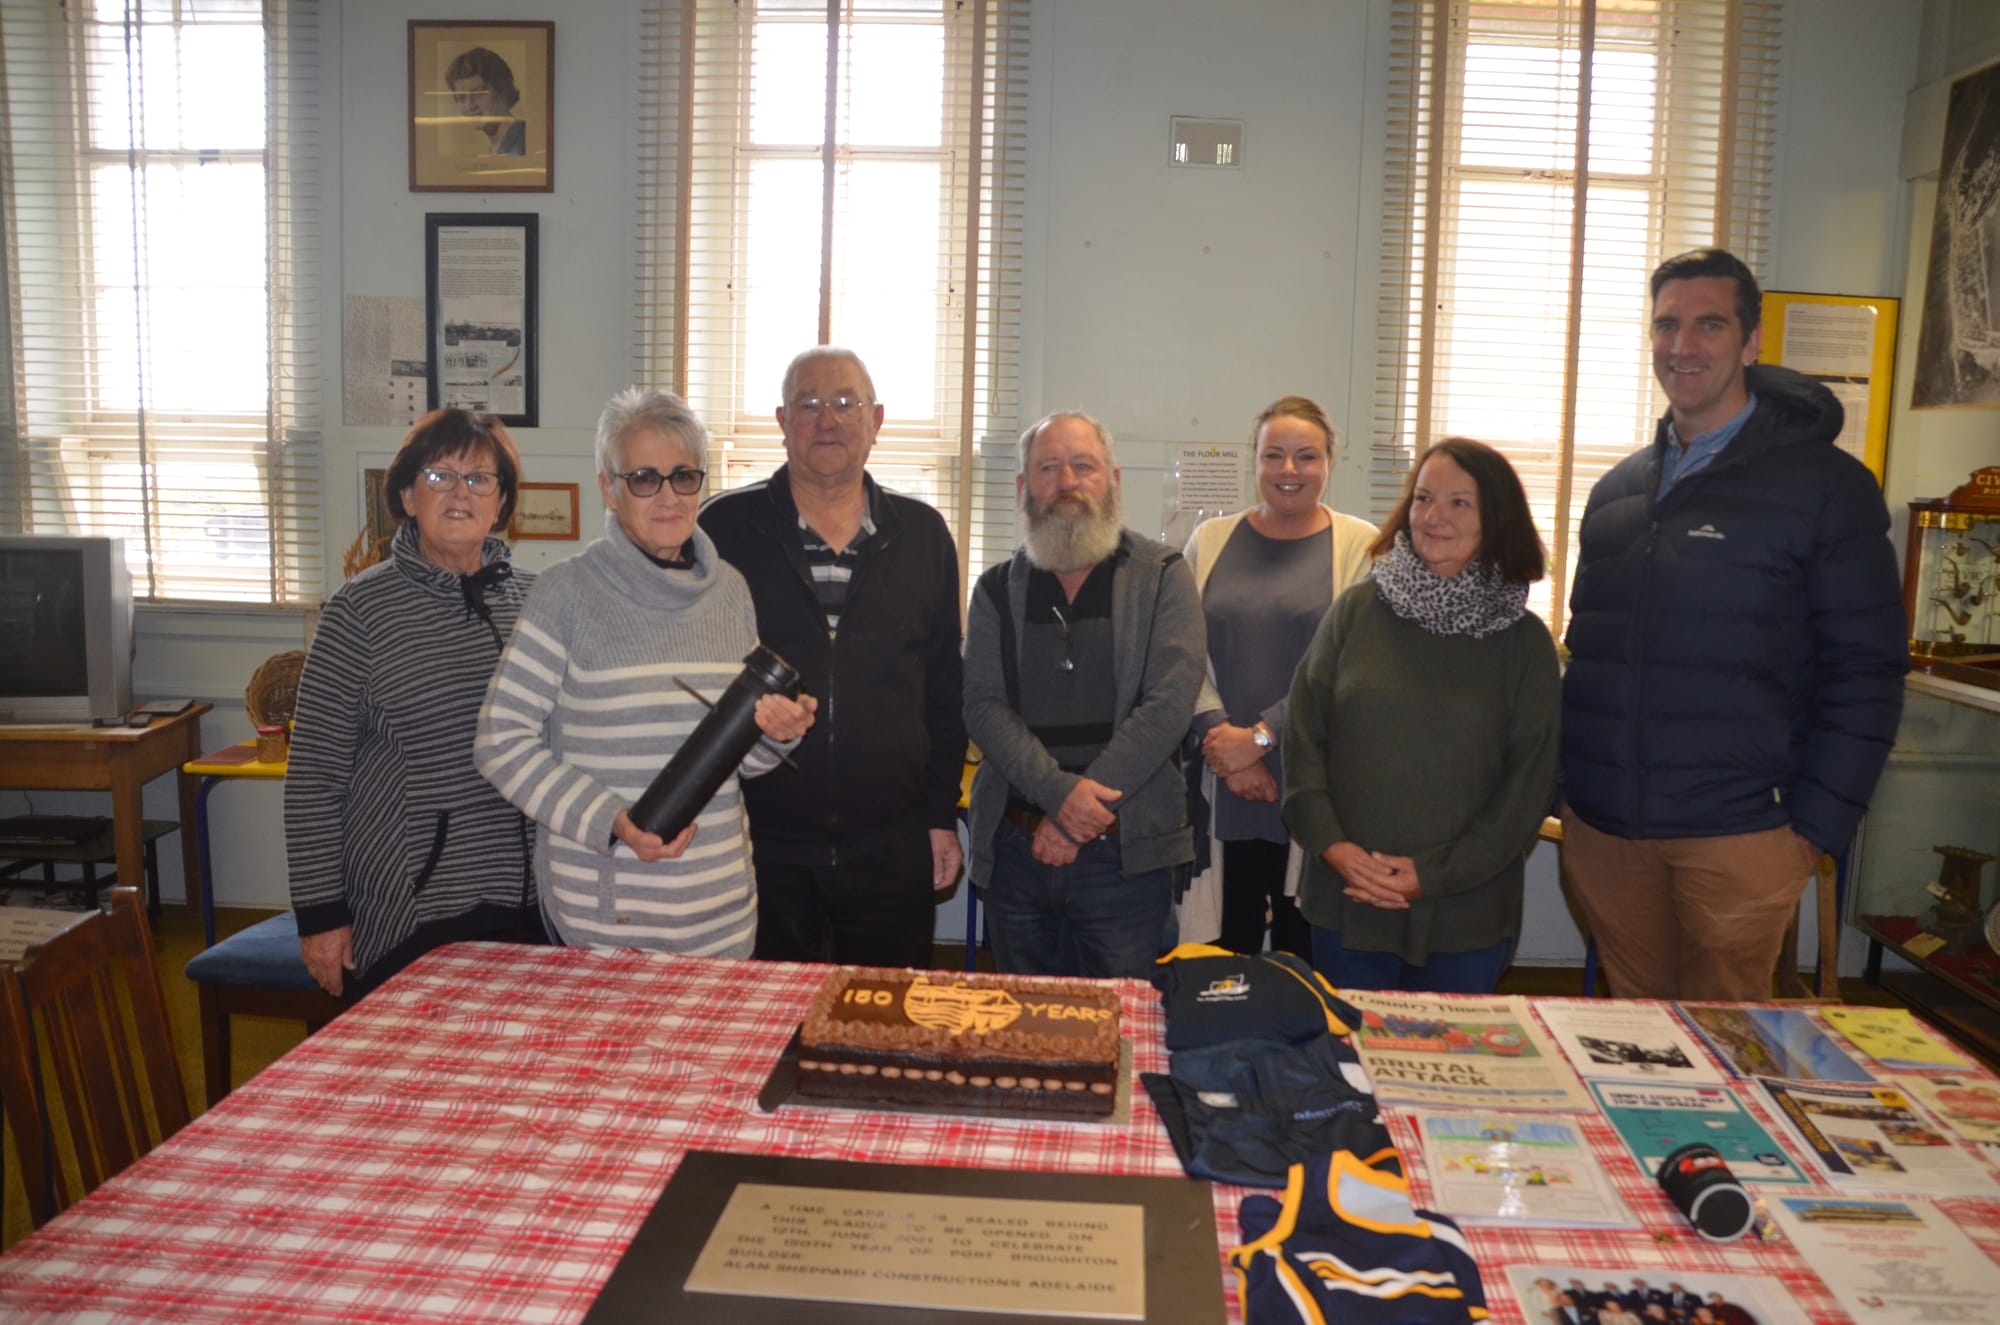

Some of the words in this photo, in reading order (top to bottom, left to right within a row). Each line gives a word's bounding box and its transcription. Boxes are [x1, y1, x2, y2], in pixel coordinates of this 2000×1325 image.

[843, 988, 893, 1006] 150
[1358, 995, 1427, 1013] Country
[1437, 1003, 1491, 1014] Times
[1368, 1056, 1484, 1075] BRUTAL
[1373, 1067, 1491, 1087] ATTACK
[761, 1203, 771, 1211] A
[789, 1204, 825, 1214] TIME
[965, 1215, 1029, 1227] SEALED
[1046, 1220, 1109, 1231] BEHIND
[772, 1215, 807, 1226] THIS
[906, 1223, 925, 1233] TO
[944, 1226, 964, 1235] BE
[982, 1228, 1051, 1239] OPENED
[1068, 1232, 1094, 1241] ON
[737, 1234, 766, 1245] THE
[784, 1238, 832, 1250] 150TH
[850, 1243, 893, 1254] YEAR
[909, 1247, 933, 1256] OF
[950, 1249, 993, 1261] PORT
[1011, 1252, 1118, 1267] BROUGHTON
[952, 1238, 973, 1247] TO
[989, 1240, 1085, 1253] CELEBRATE
[722, 1259, 770, 1272] ALAN
[776, 1263, 866, 1279] SHEPPARD
[872, 1270, 1021, 1289] CONSTRUCTIONS
[1029, 1280, 1117, 1293] ADELAIDE
